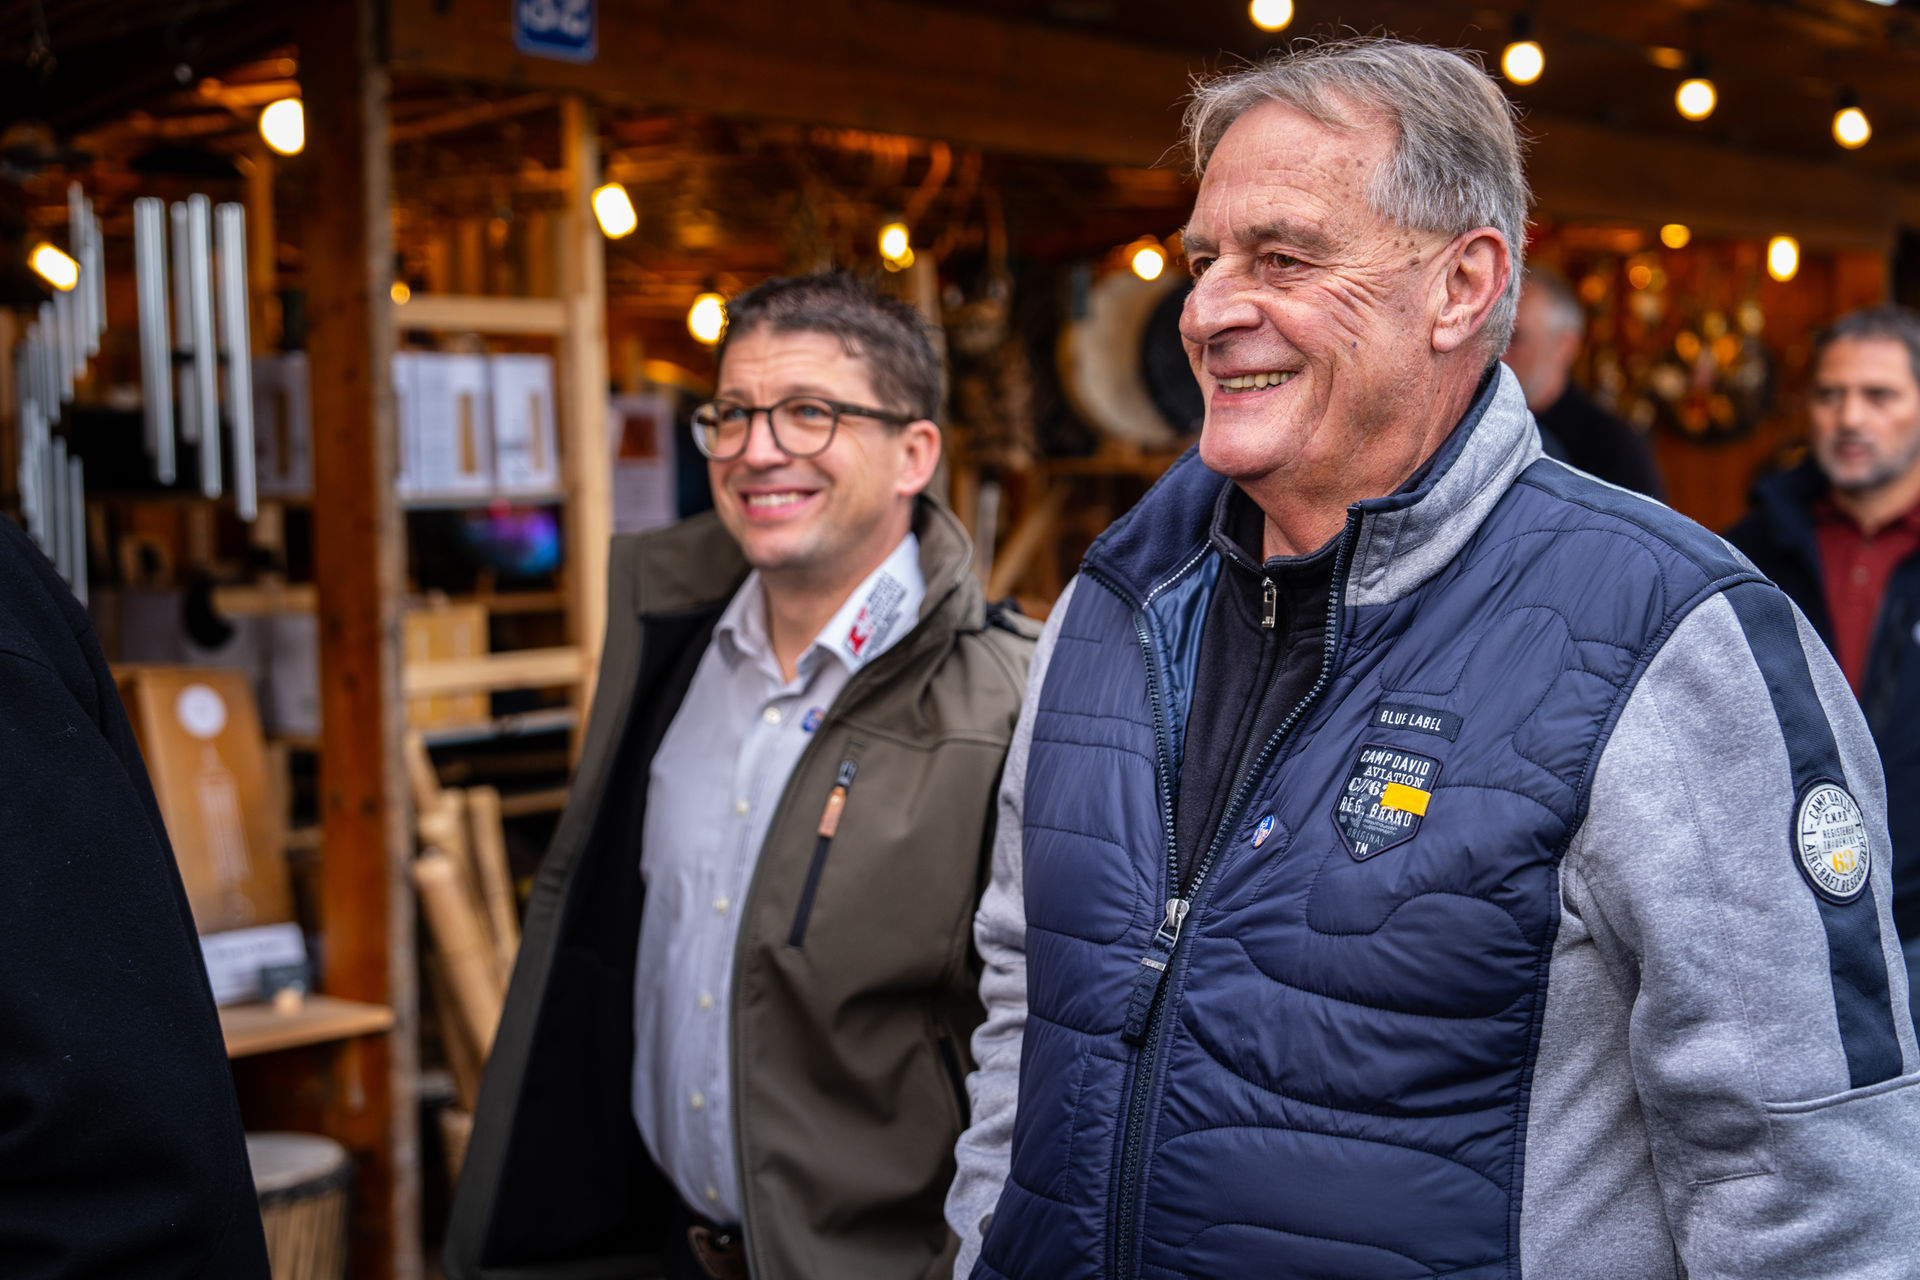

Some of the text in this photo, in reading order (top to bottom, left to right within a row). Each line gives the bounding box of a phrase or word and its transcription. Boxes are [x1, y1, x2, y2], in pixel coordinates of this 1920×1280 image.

[1380, 710, 1442, 731] BLUE LABEL
[1360, 750, 1430, 776] CAMP DAVID
[1363, 766, 1425, 788] AVIATION
[1369, 803, 1413, 827] BRAND
[1808, 794, 1827, 820] CAMP
[1346, 828, 1385, 847] ORIGINAL
[1354, 841, 1369, 855] TM
[1805, 843, 1840, 890] AIRCRAFT
[1832, 849, 1855, 873] 63
